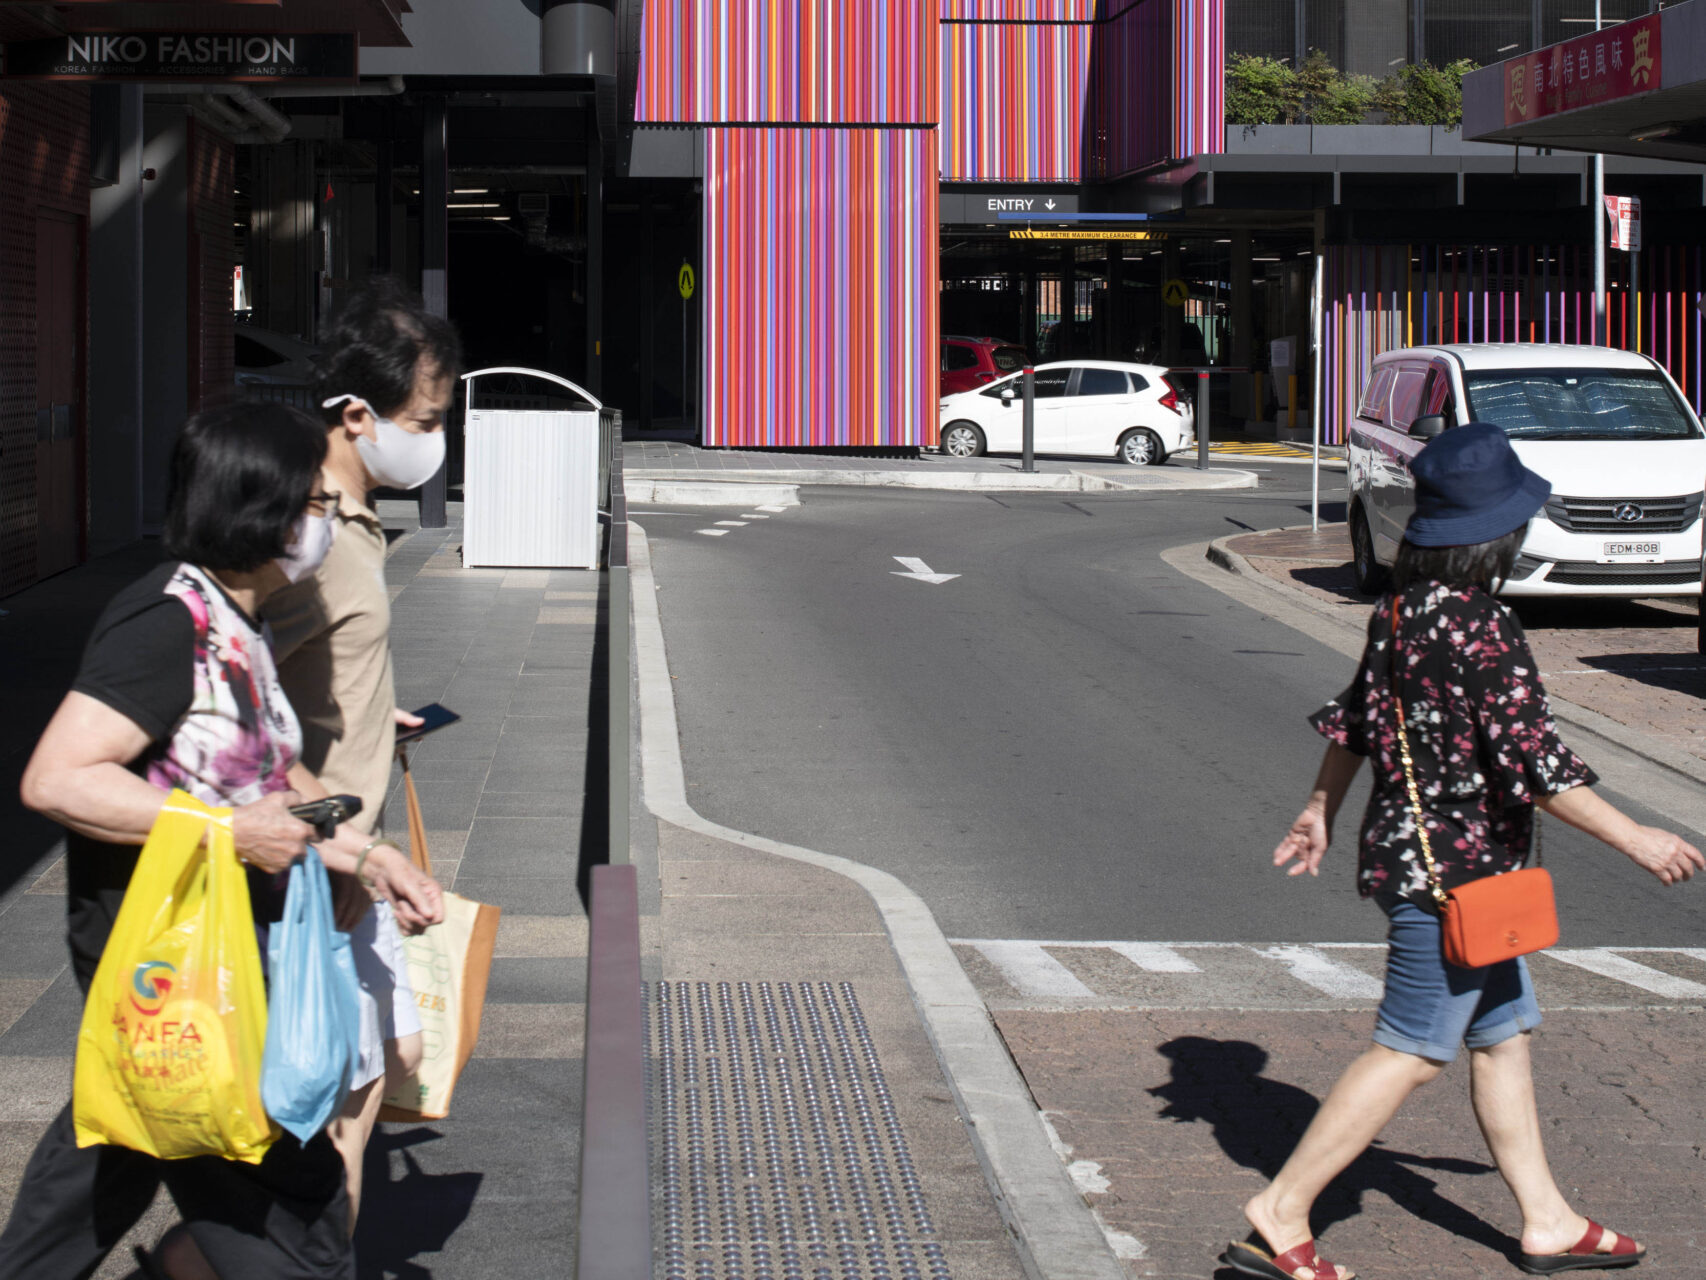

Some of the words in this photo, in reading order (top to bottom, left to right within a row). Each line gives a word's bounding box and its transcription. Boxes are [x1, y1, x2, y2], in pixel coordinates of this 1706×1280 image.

[67, 36, 147, 63] NIKO
[158, 35, 295, 64] FASHION
[54, 65, 87, 74] KOREA
[92, 65, 136, 74] FASHION
[159, 65, 225, 74] ACCESSORIES
[248, 66, 277, 75] HAND
[1533, 36, 1623, 94] 南北特色風味
[988, 199, 1034, 211] ENTRY
